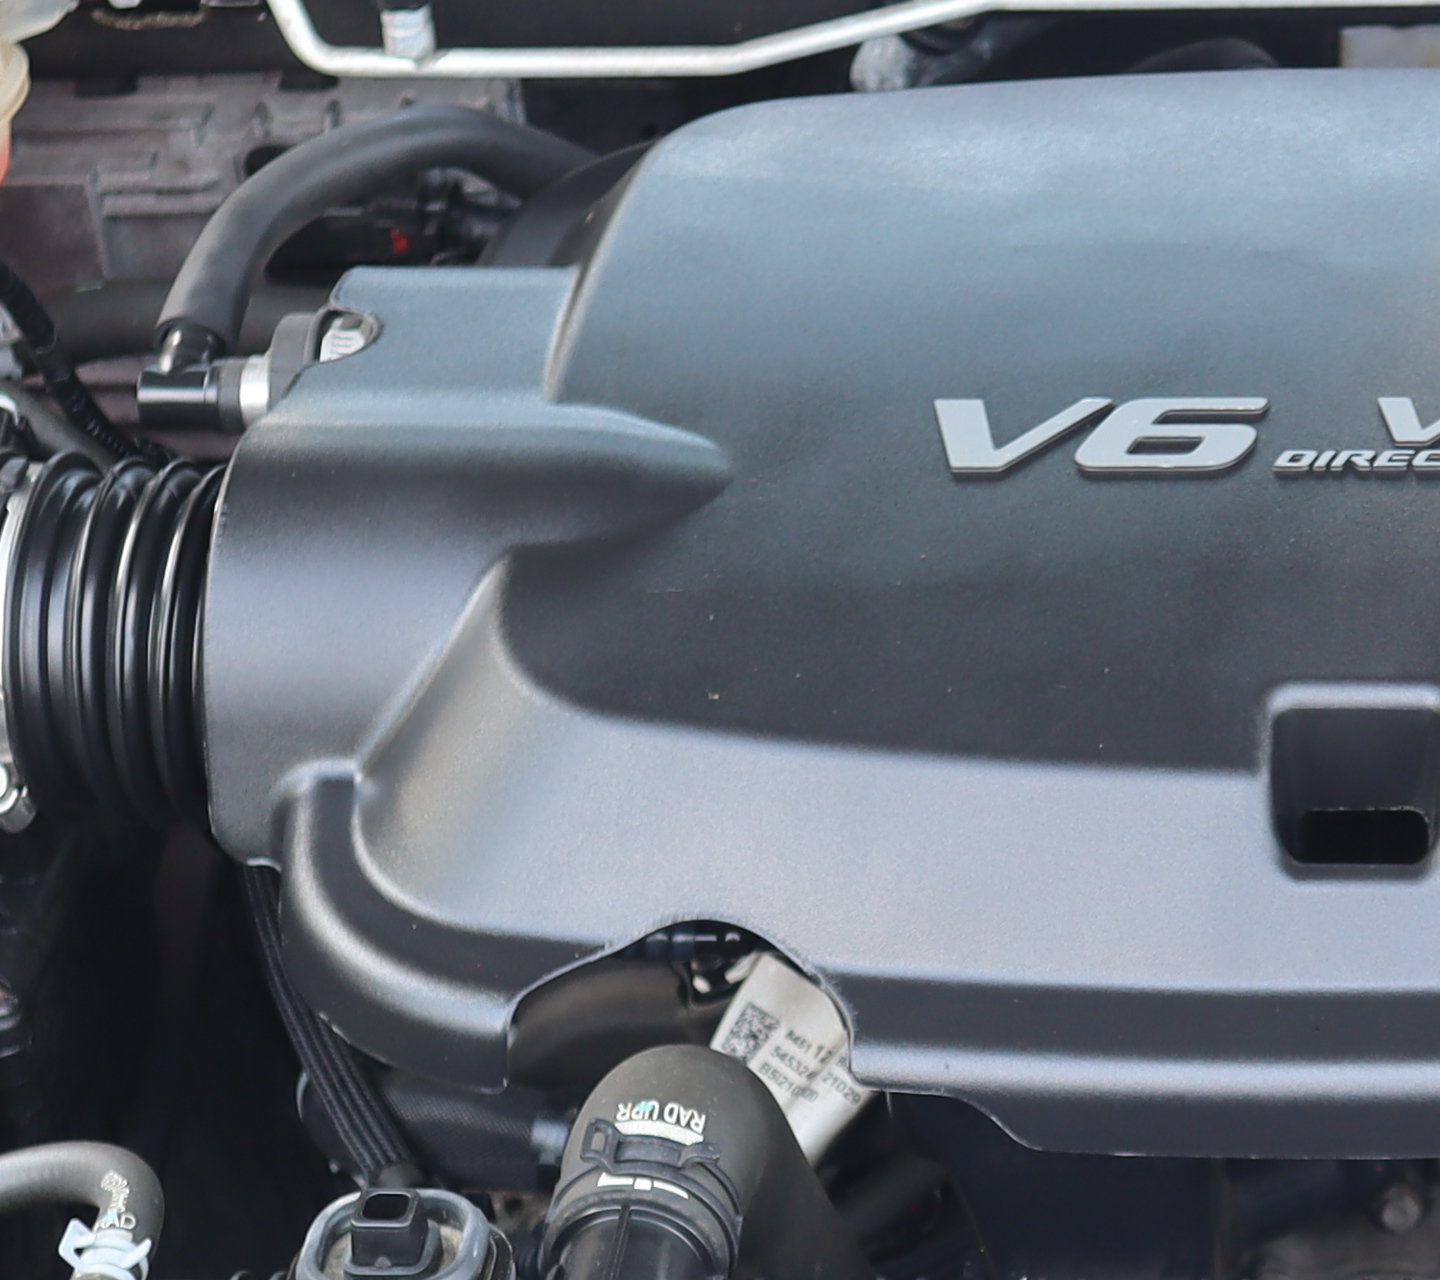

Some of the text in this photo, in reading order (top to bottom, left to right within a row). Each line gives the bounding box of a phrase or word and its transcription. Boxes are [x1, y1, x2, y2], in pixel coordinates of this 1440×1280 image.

[934, 396, 1269, 474] V6
[616, 1099, 706, 1133] RAD UPR
